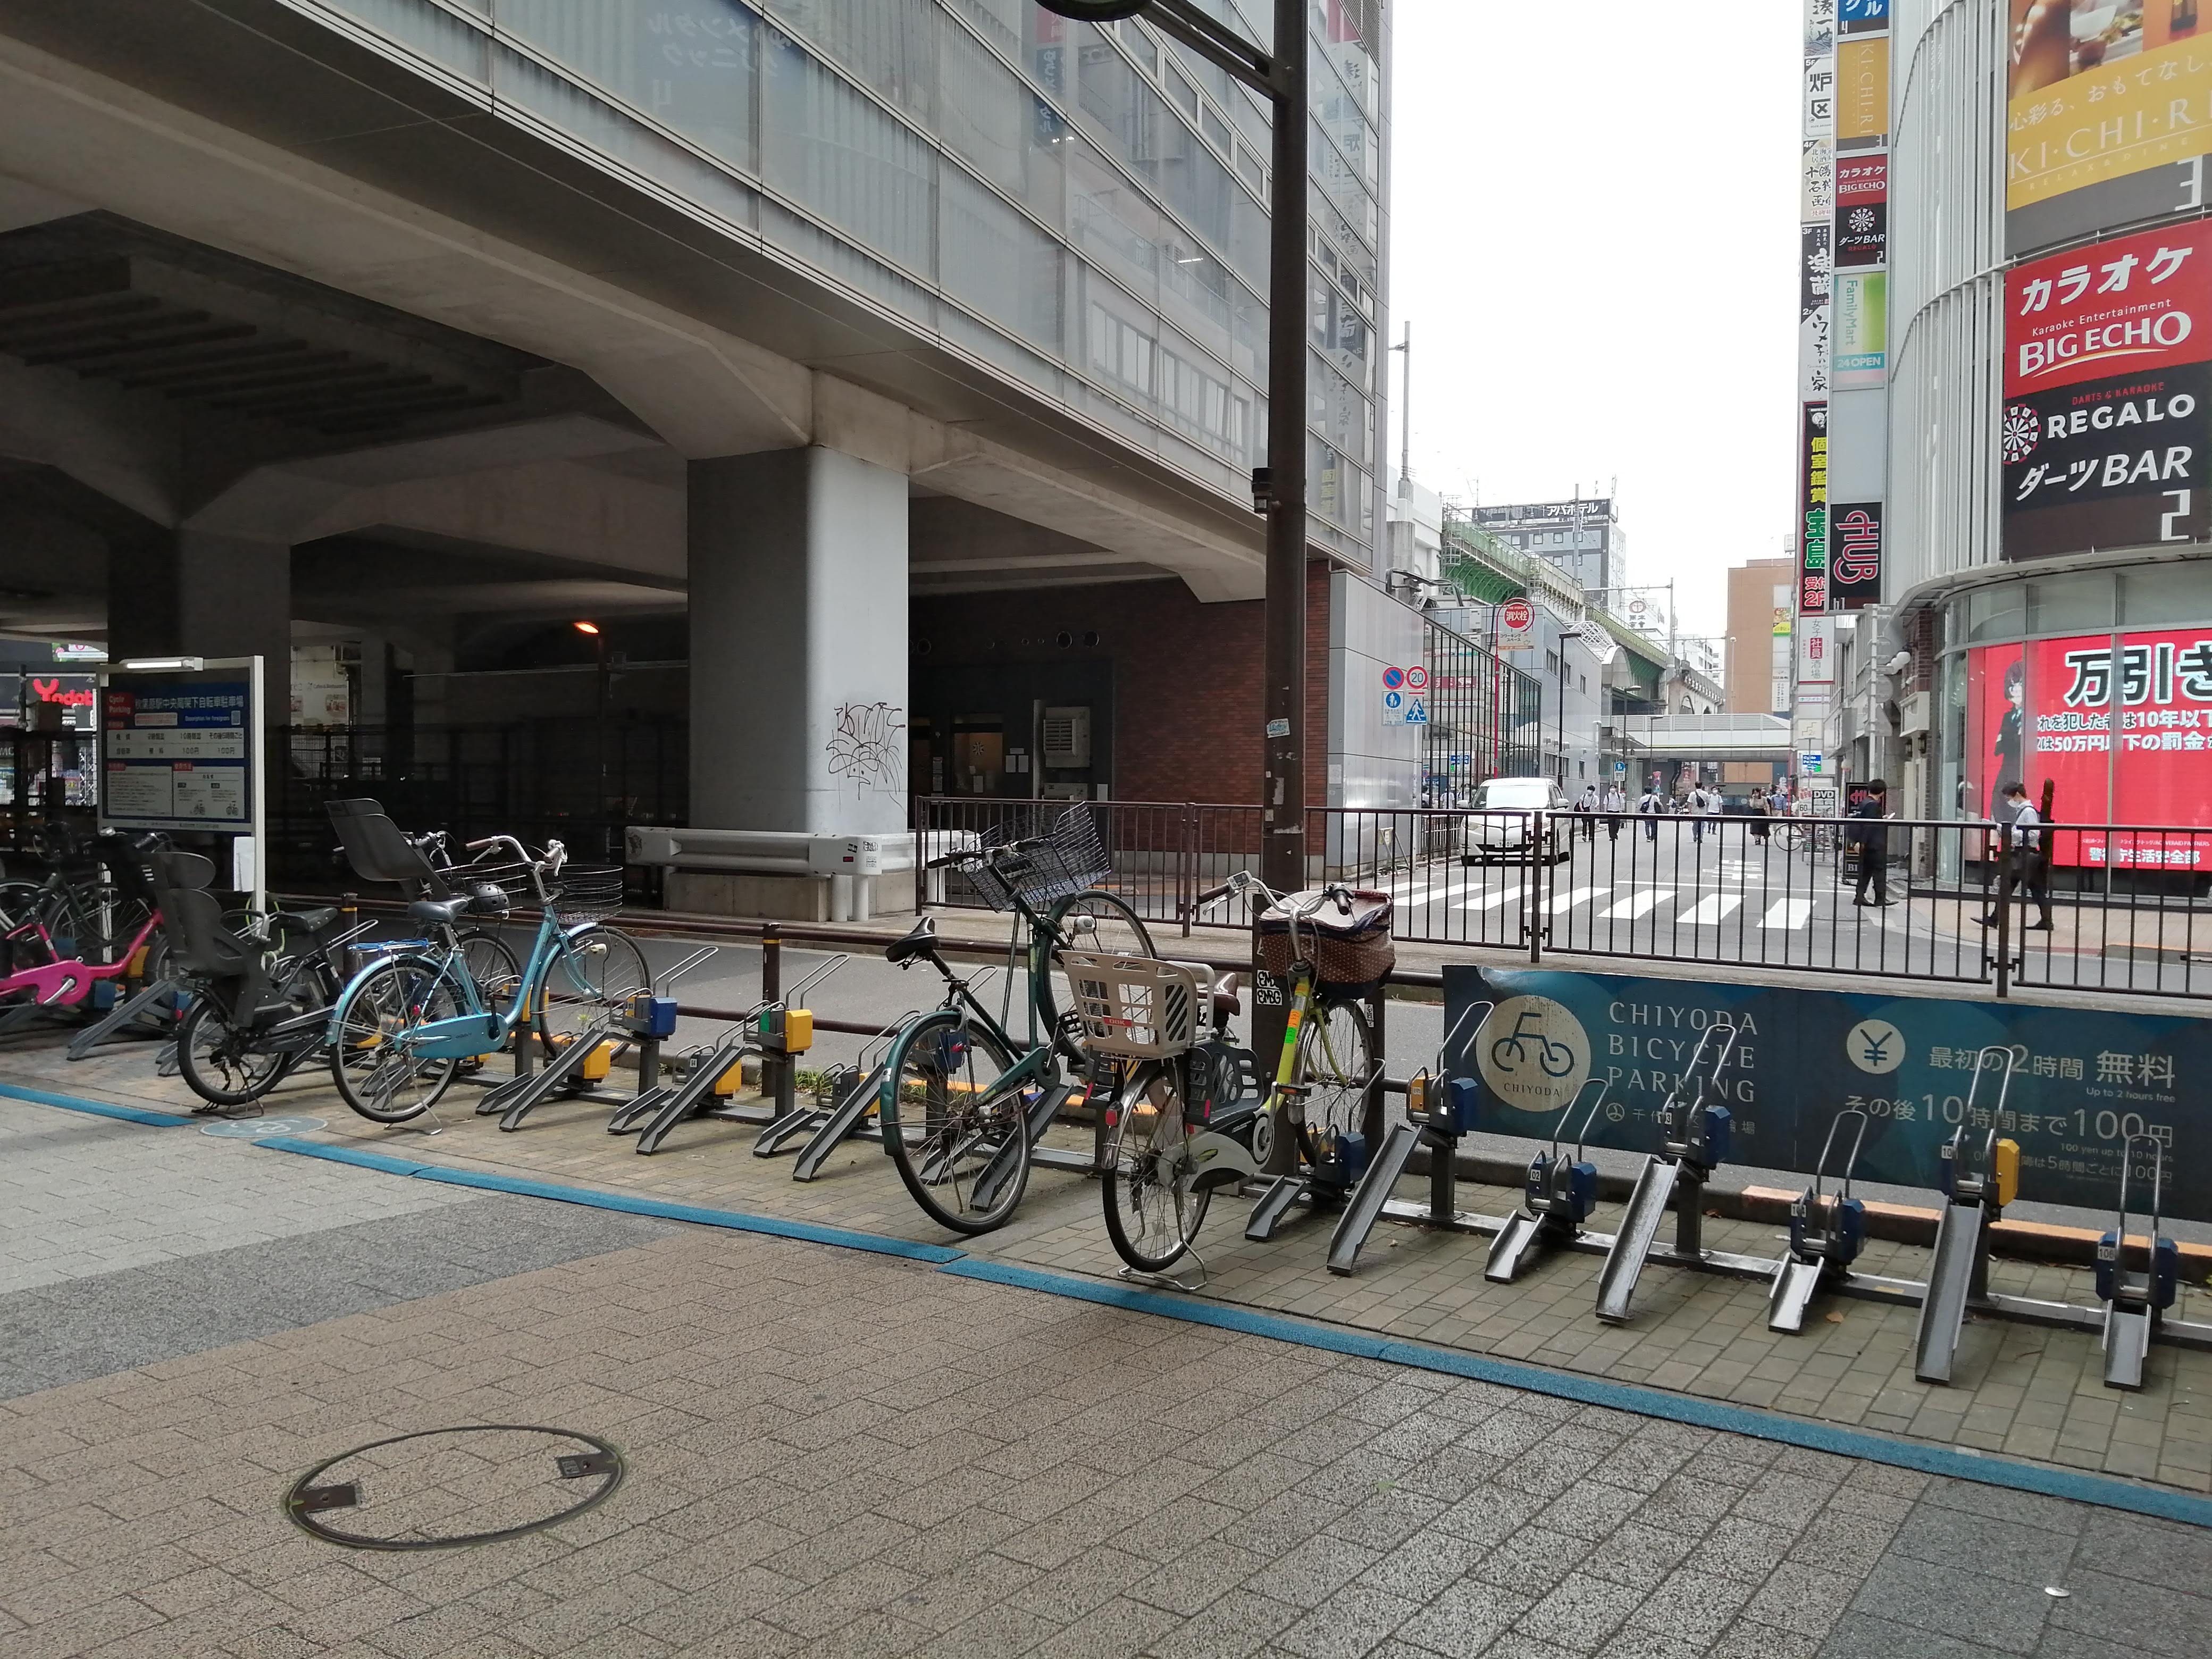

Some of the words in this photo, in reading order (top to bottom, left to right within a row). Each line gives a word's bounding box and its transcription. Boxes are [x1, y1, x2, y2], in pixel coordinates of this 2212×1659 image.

[1841, 20, 1848, 33] 4
[1839, 165, 1886, 179] カラオケ
[1839, 185, 1857, 194] BIG
[1859, 181, 1886, 190] ECHO
[2021, 247, 2193, 316] カラオケ
[1843, 280, 1858, 346] FamilyMart
[2032, 320, 2074, 337] Karaoke
[2080, 298, 2172, 325] Entertainment
[2020, 333, 2077, 377] BIG
[2085, 311, 2192, 351] ECHO
[2072, 392, 2101, 406] DARTS
[2116, 382, 2164, 398] KARAOKE
[2048, 394, 2196, 439] REGALO
[2161, 489, 2191, 541] 2
[1833, 510, 1879, 584] HUB
[1506, 610, 1528, 622] 消火栓
[1411, 672, 1424, 683] 20
[1609, 1001, 1758, 1035] CHIYODA
[1607, 1033, 1755, 1069] BICYCLE
[1929, 1044, 2084, 1081] 最初の2時間
[2096, 1050, 2175, 1089] 無料
[1504, 1083, 1560, 1097] CHIYODA
[1606, 1066, 1754, 1102] PARKING
[2086, 1087, 2100, 1097] Up
[2104, 1088, 2113, 1097] to
[2117, 1090, 2123, 1098] 2
[2126, 1091, 2154, 1101] hours
[2156, 1093, 2176, 1103] free
[2081, 1145, 2099, 1155] yen
